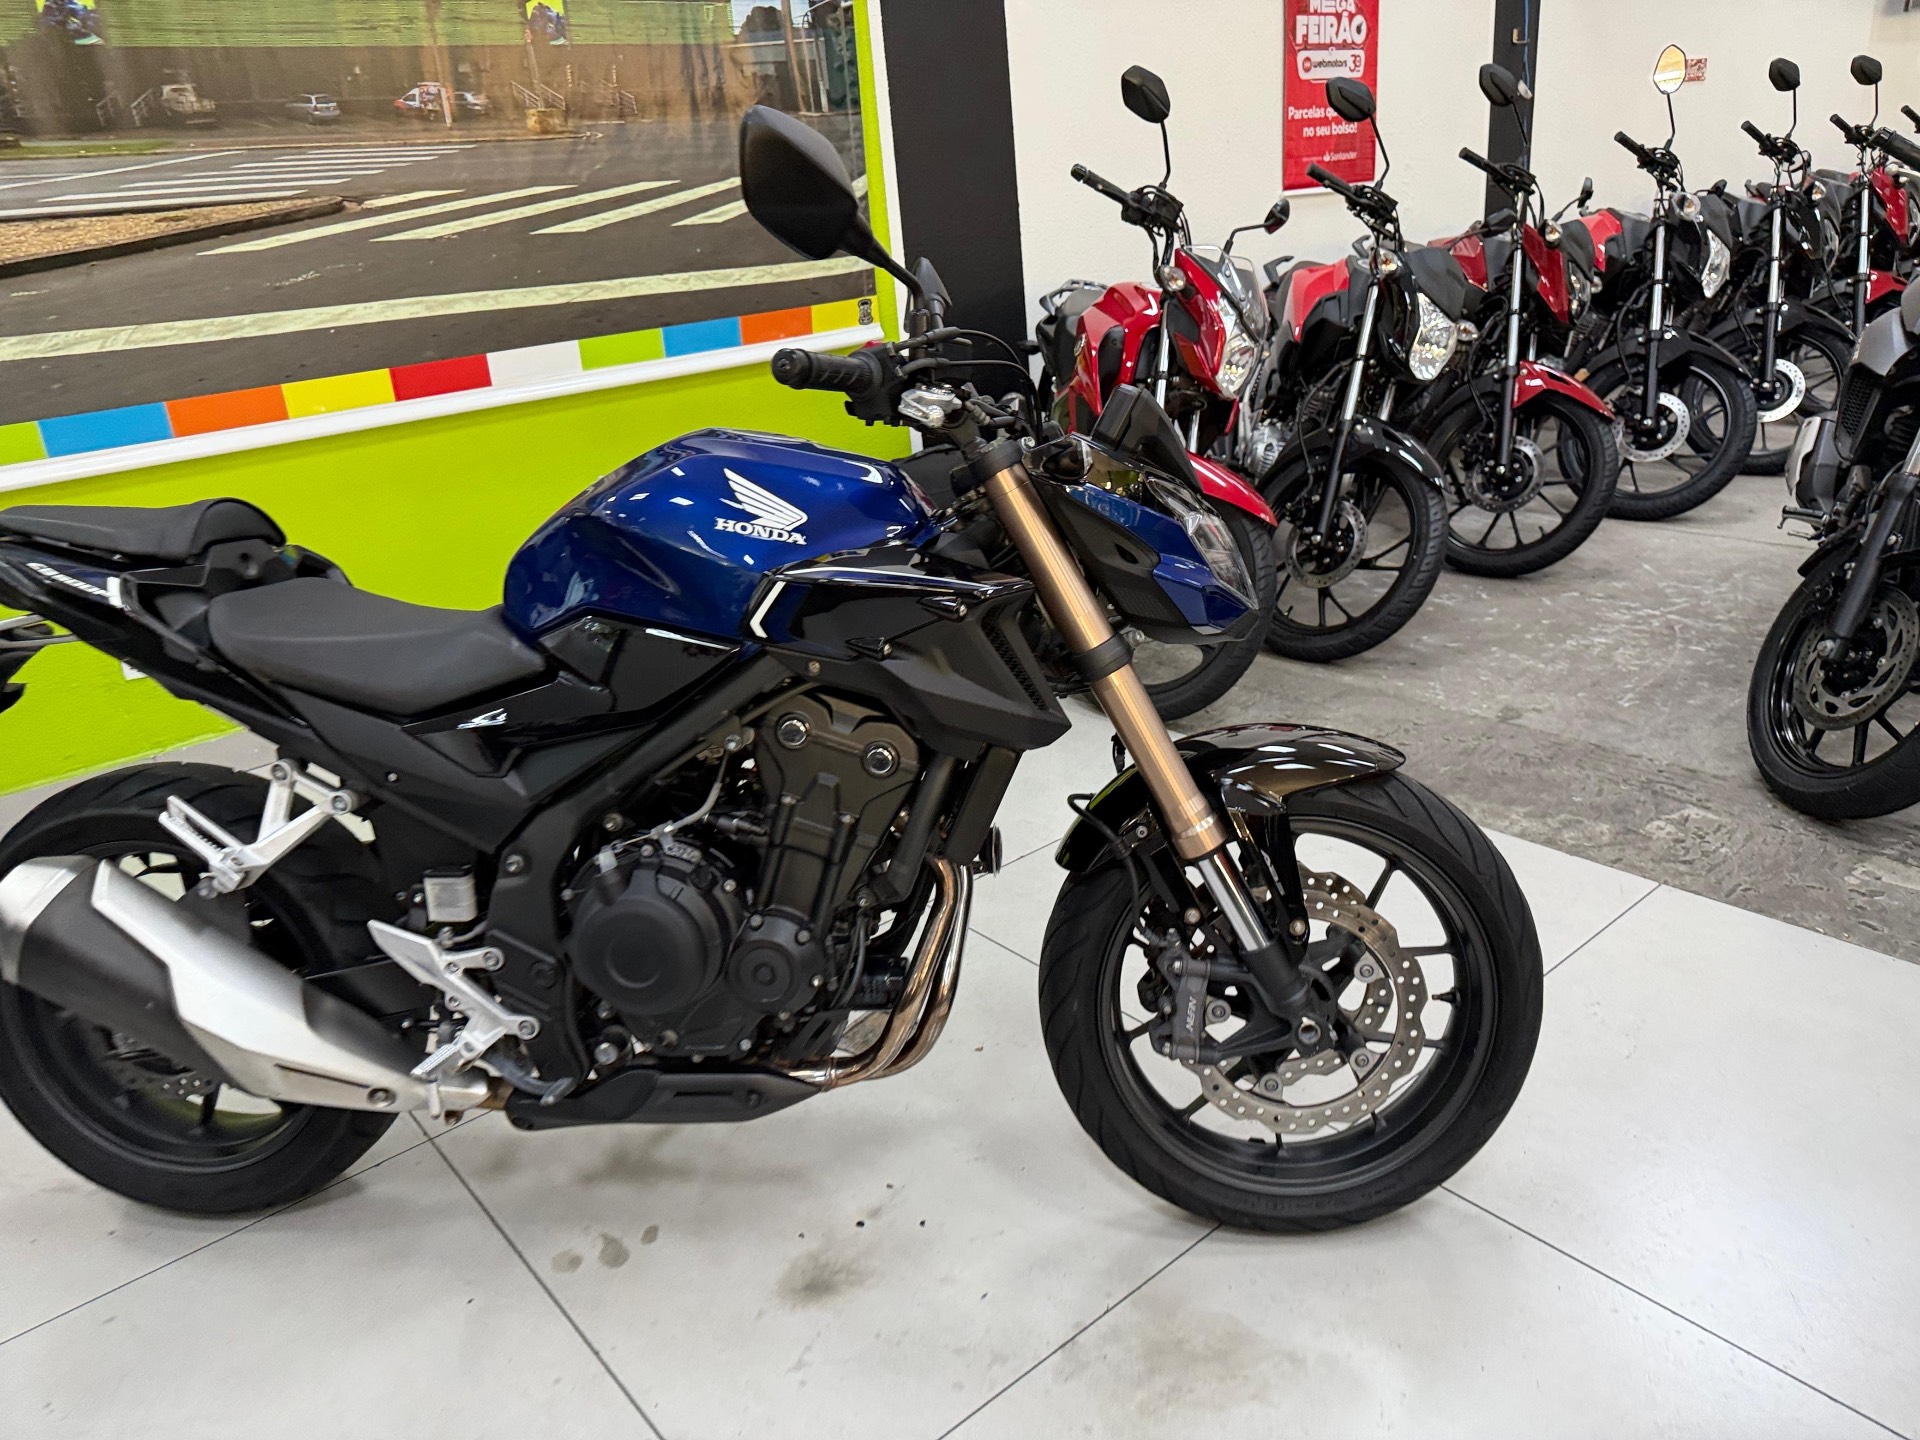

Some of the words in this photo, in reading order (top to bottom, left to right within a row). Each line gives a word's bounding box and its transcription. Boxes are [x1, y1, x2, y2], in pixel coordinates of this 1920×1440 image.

[1310, 0, 1356, 14] MEGA
[1296, 11, 1367, 44] FEIRÃO
[1312, 59, 1347, 68] webmotors
[1288, 105, 1325, 120] Parcelas
[1326, 106, 1338, 121] qu
[1303, 126, 1315, 137] no
[1316, 125, 1331, 136] seu
[1332, 121, 1358, 135] bolso!
[1330, 152, 1357, 161] Santander
[714, 517, 807, 545] HONDA
